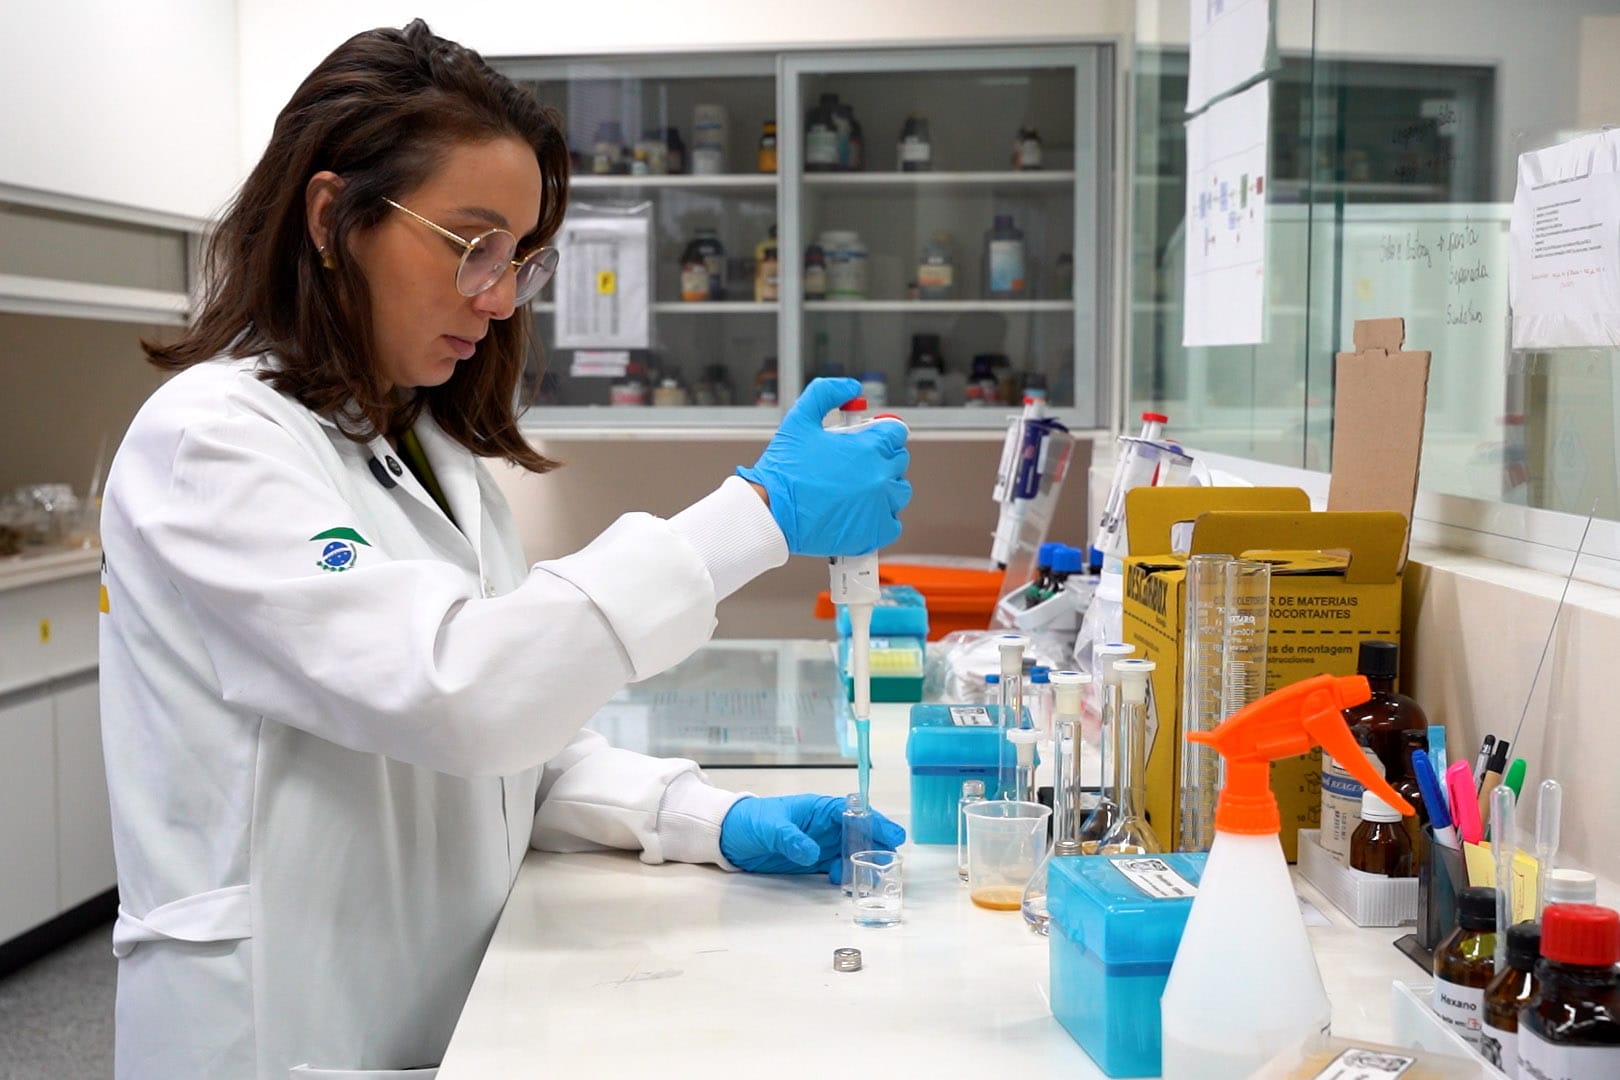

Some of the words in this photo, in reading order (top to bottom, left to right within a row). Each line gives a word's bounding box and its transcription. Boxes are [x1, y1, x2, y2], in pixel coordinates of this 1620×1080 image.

[1279, 596, 1294, 606] DE
[1298, 596, 1358, 606] MATERIAIS
[1281, 644, 1294, 653] de
[1297, 645, 1353, 656] montagem
[1331, 780, 1365, 792] REAGEN
[1440, 993, 1477, 1011] Hexano
